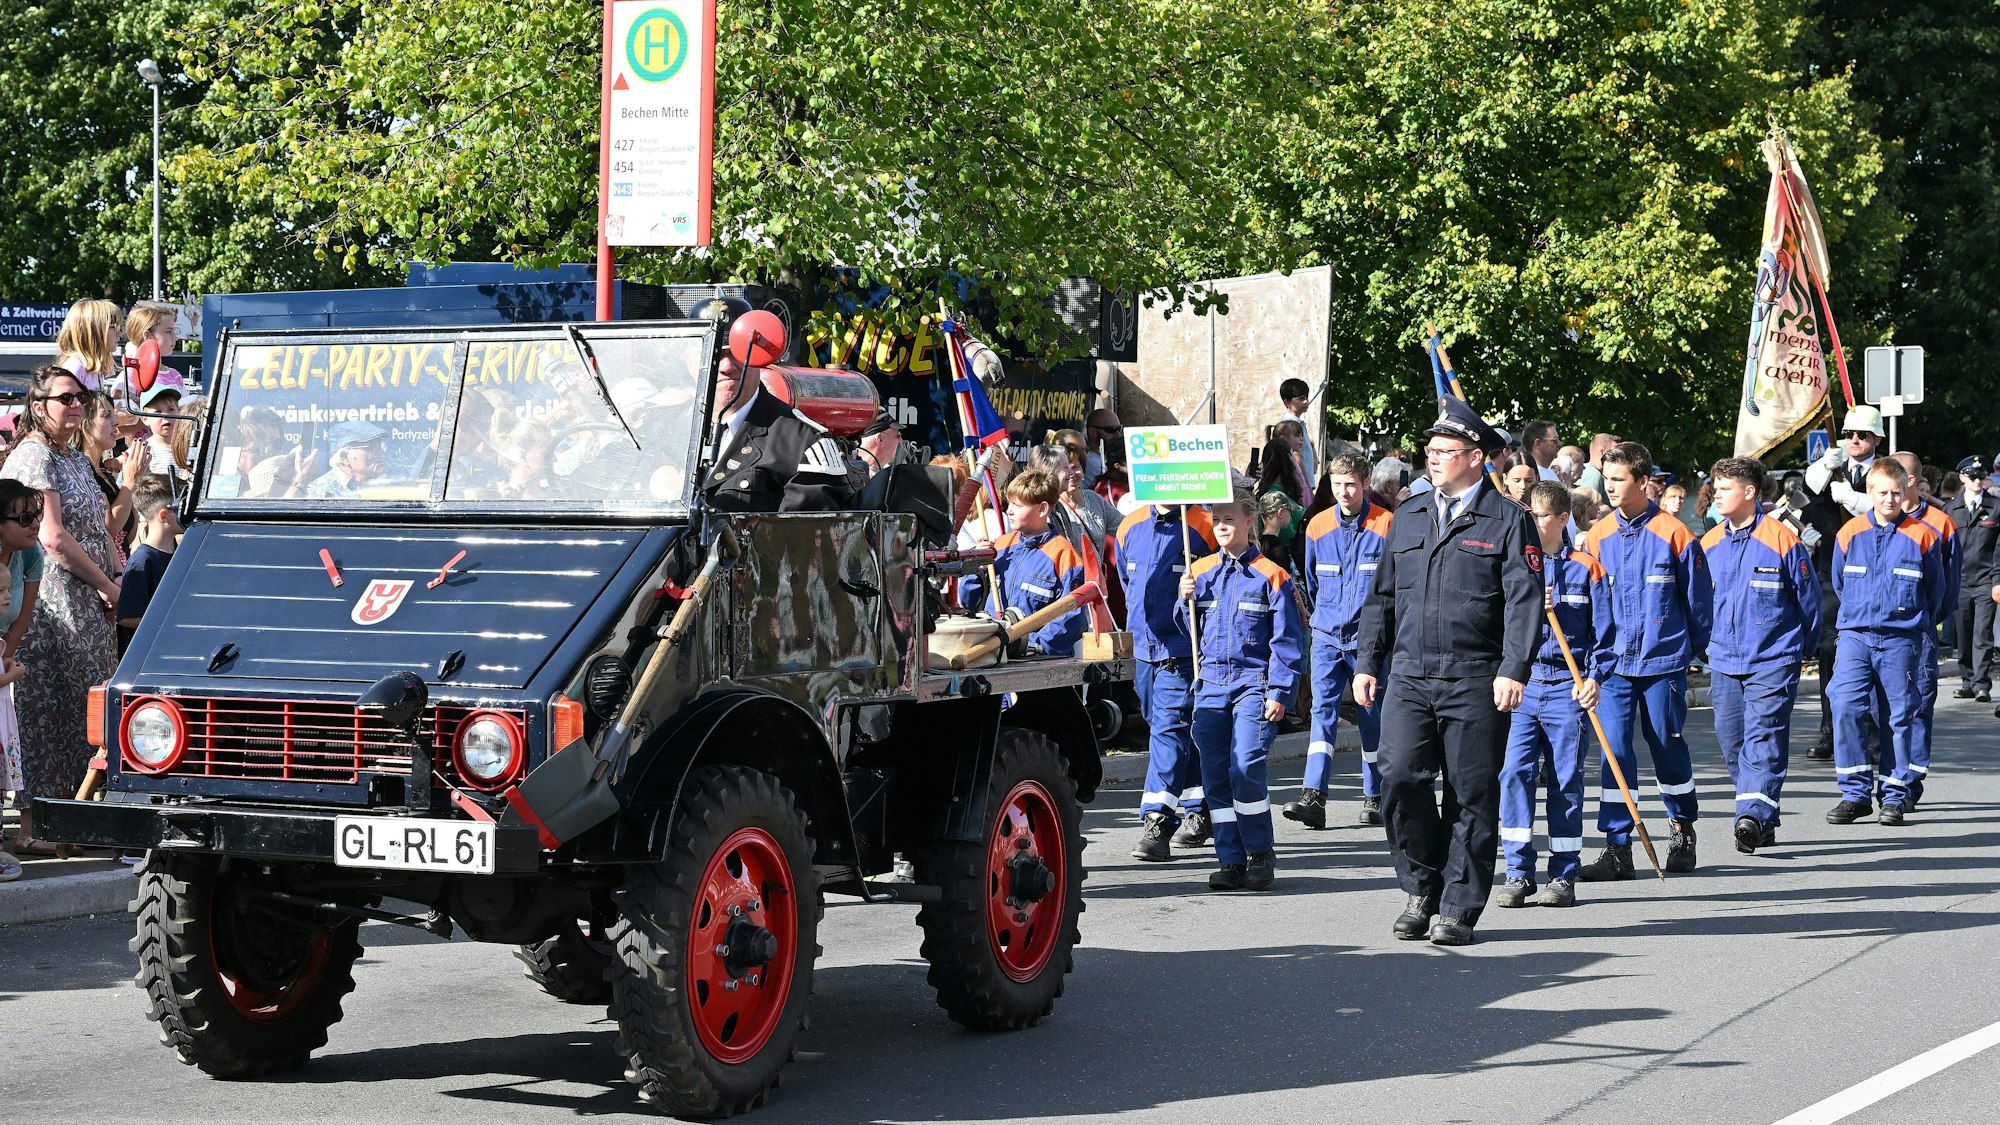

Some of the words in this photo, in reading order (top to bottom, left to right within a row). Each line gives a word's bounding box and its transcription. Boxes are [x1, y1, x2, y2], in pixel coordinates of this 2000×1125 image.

[644, 24, 670, 66] H
[621, 107, 658, 119] Bechen
[661, 106, 689, 118] Mitte
[614, 139, 635, 152] 427
[613, 161, 634, 173] 454
[613, 184, 632, 195] N43
[672, 216, 687, 224] VRS
[1, 306, 10, 318] &
[0, 322, 37, 336] erner
[40, 320, 63, 337] Gb
[1769, 330, 1820, 353] mens
[240, 402, 420, 424] ränkevertrieb
[426, 402, 440, 421] &
[1168, 438, 1224, 452] Bechen
[1135, 473, 1158, 482] FREIW.
[1159, 472, 1199, 481] FEUERWEHR
[1154, 482, 1180, 492] EINHEIT
[1181, 482, 1207, 491] BECHEN
[1462, 540, 1495, 549] FEUERWEHR
[455, 828, 488, 868] 61
